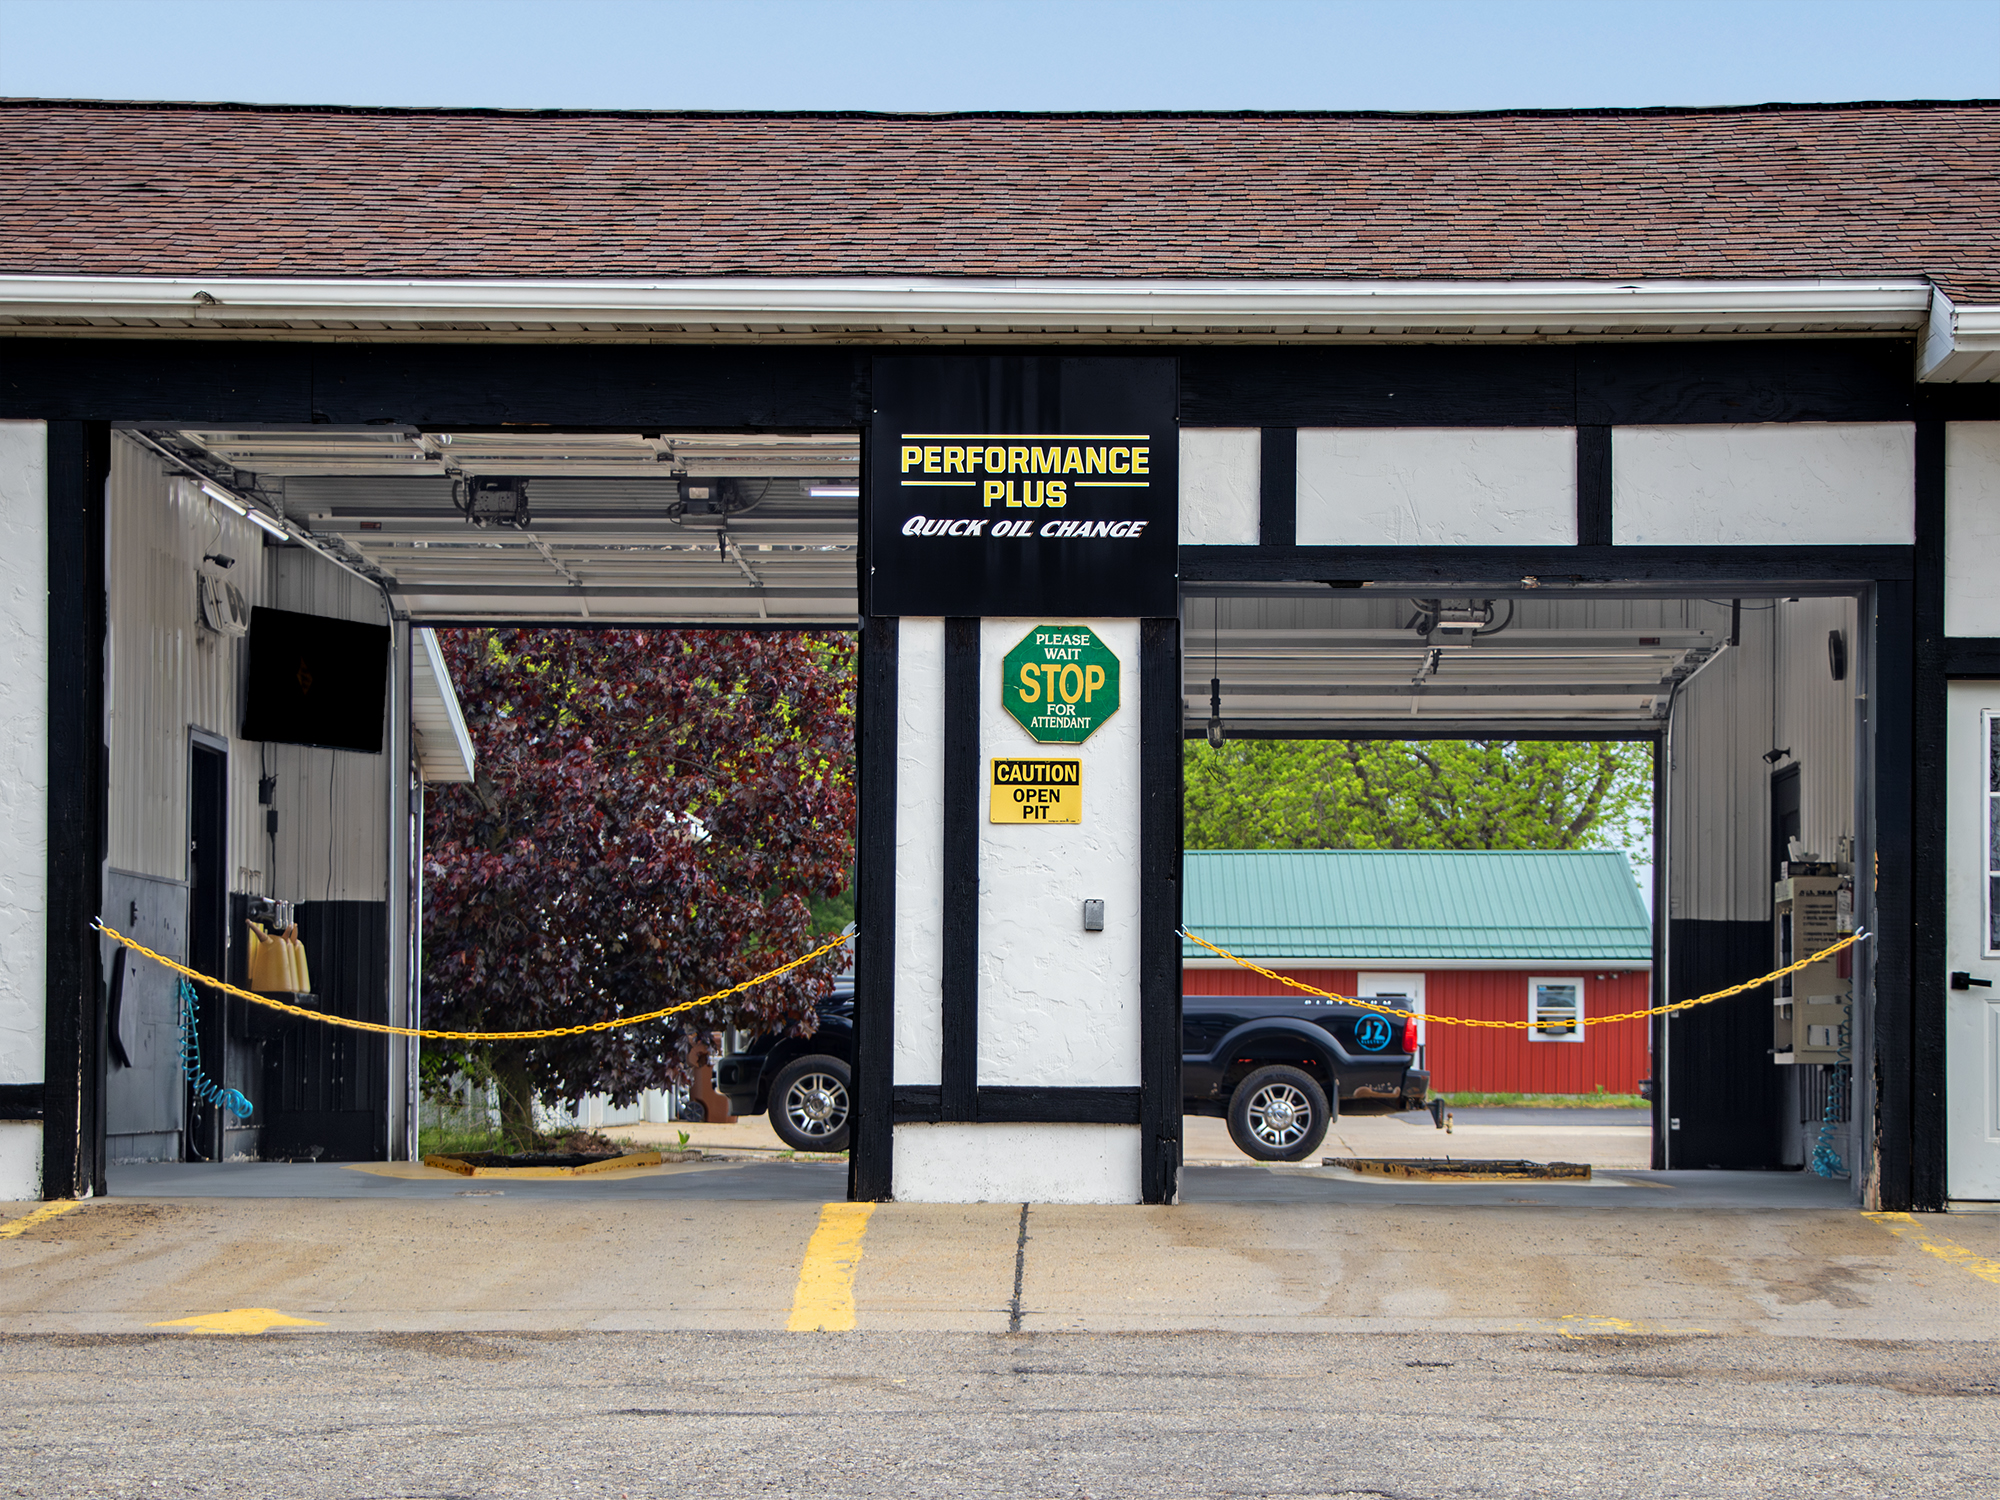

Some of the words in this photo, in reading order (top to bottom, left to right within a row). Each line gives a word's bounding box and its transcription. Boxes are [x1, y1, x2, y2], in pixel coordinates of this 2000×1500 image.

[901, 446, 1150, 474] PERFORMANCE
[983, 480, 1067, 508] PLUS
[902, 515, 988, 537] QUICK
[991, 520, 1034, 538] OIL
[1040, 520, 1149, 538] CHANGE
[1036, 634, 1090, 646] PLEASE
[1044, 648, 1081, 660] WAIT
[1019, 662, 1106, 703] STOP
[1047, 704, 1076, 715] FOR
[1031, 716, 1091, 729] ATTENDANT
[997, 764, 1077, 782] CAUTION
[1013, 788, 1060, 803] OPEN
[1023, 805, 1050, 819] PIT
